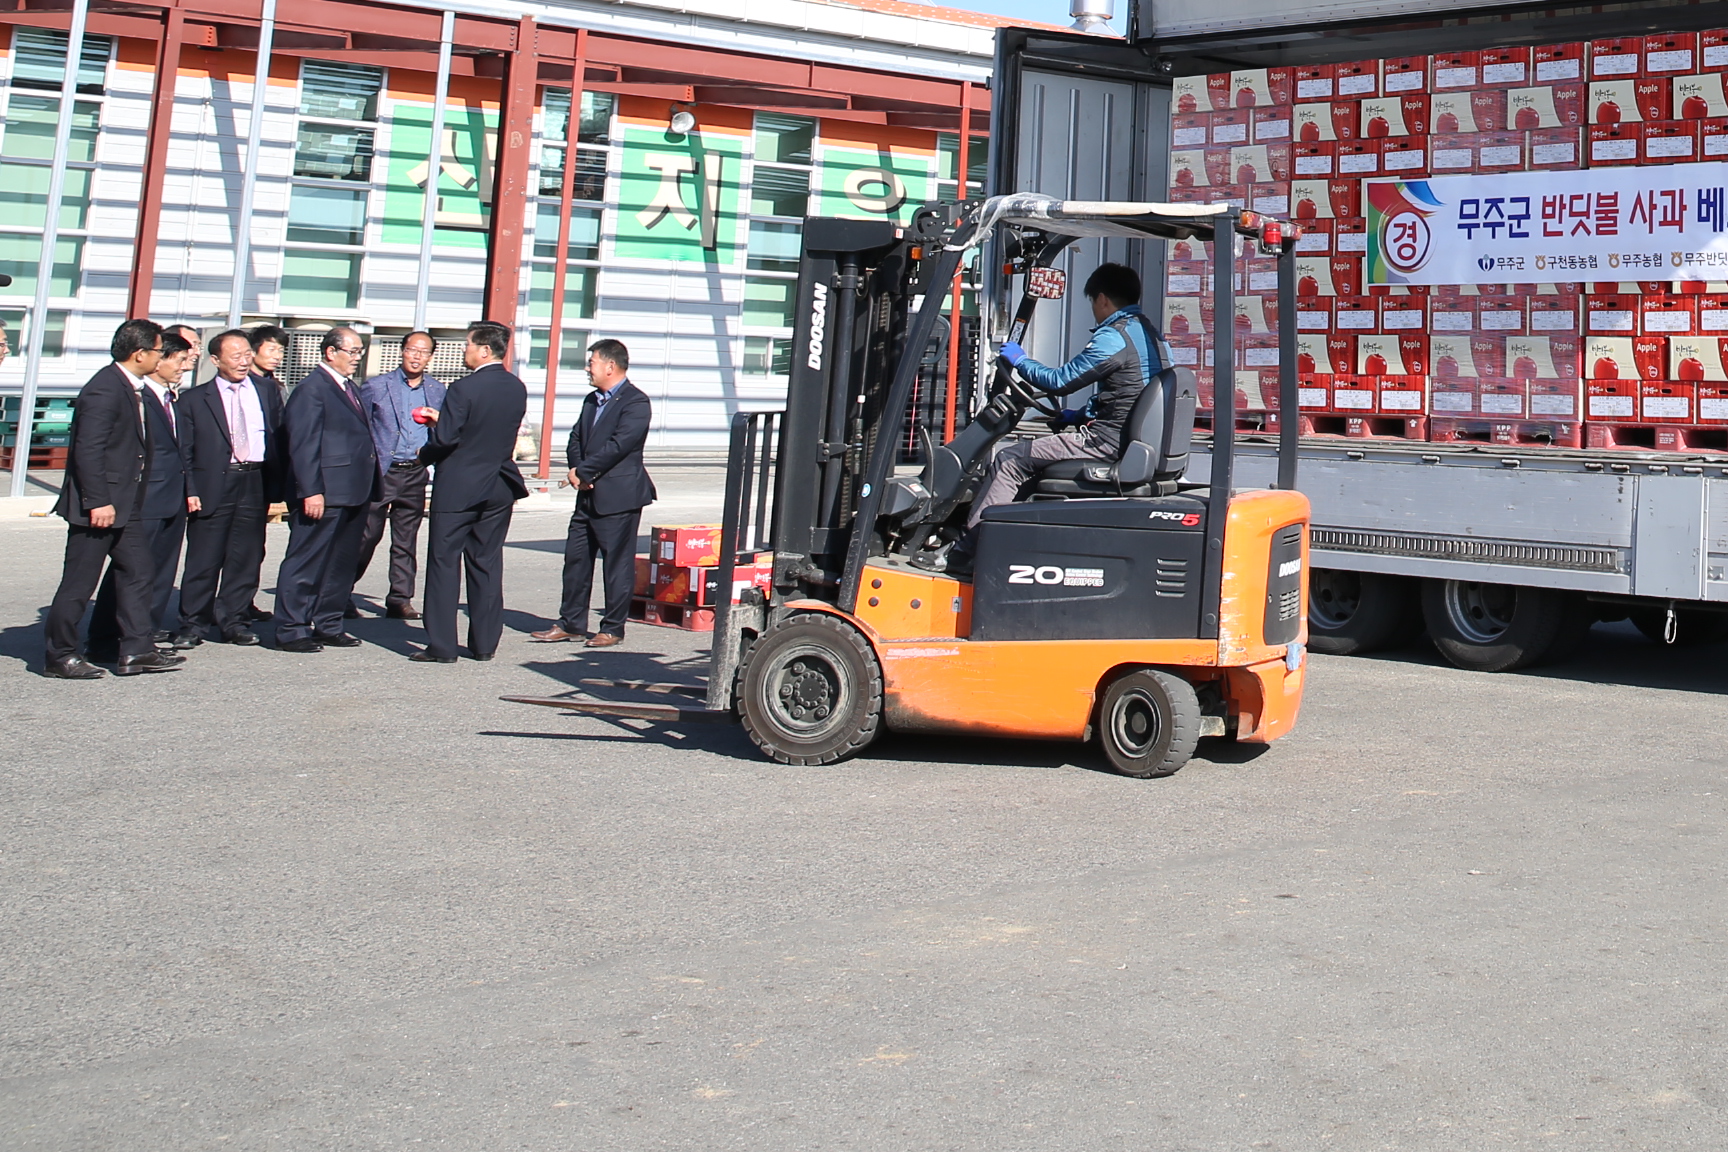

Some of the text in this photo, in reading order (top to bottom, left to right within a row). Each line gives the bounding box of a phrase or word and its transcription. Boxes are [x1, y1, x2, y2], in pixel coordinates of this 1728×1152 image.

[1210, 78, 1224, 87] Apple
[1639, 85, 1658, 93] Apple
[1557, 90, 1576, 99] Apple
[1405, 101, 1422, 109] Apple
[1475, 97, 1492, 105] Apple
[1334, 107, 1349, 115] Apple
[1332, 185, 1348, 193] Apple
[1457, 196, 1531, 241] 무주군
[1540, 192, 1620, 237] 반딧불
[1628, 188, 1687, 235] 사과
[1393, 221, 1418, 260] 경
[1497, 257, 1525, 270] 무주군
[1548, 255, 1598, 270] 구천동농협
[1622, 253, 1662, 268] 무주농협
[808, 282, 827, 370] DOOSAN
[1475, 342, 1492, 350] Apple
[1637, 343, 1656, 352] Apple
[1009, 565, 1064, 584] 20
